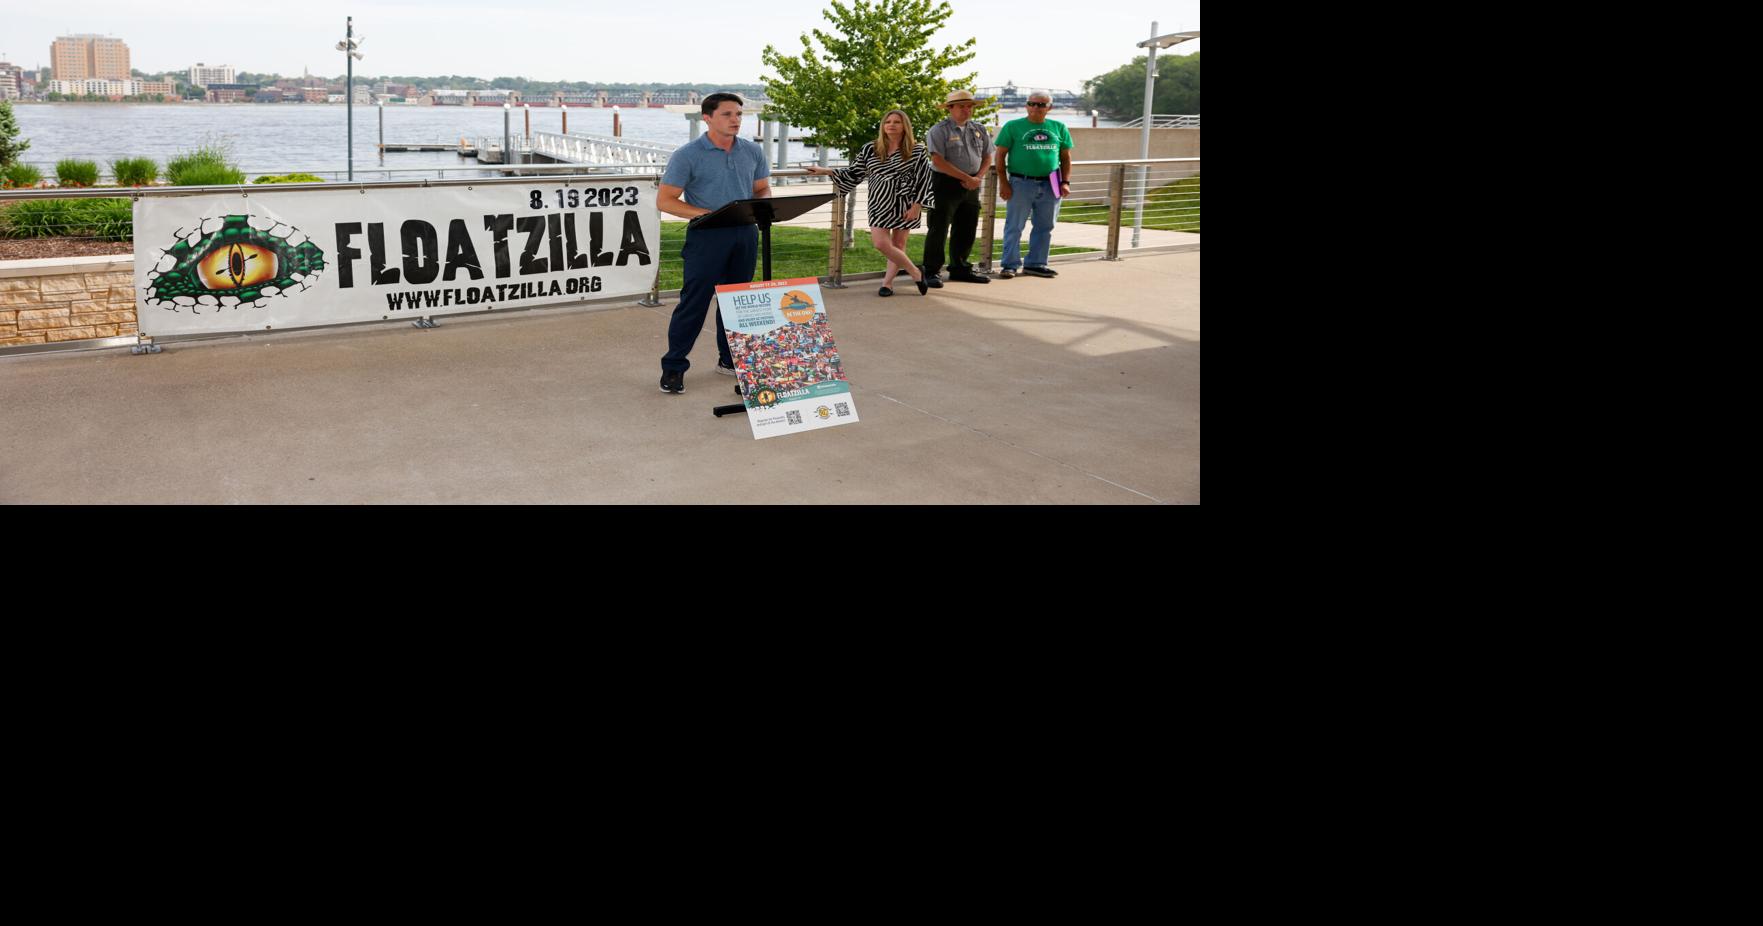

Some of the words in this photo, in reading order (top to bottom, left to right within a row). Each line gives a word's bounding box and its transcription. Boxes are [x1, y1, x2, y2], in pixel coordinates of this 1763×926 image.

[555, 188, 580, 209] 19
[584, 186, 639, 208] 2023
[335, 210, 651, 289] FLOATZILLA
[386, 276, 602, 311] WWW.FLOATZILLA.ORG
[732, 294, 756, 306] HELP
[758, 292, 772, 304] US
[748, 319, 776, 328] WEEKEND!
[777, 388, 811, 399] FLOATZILLA
